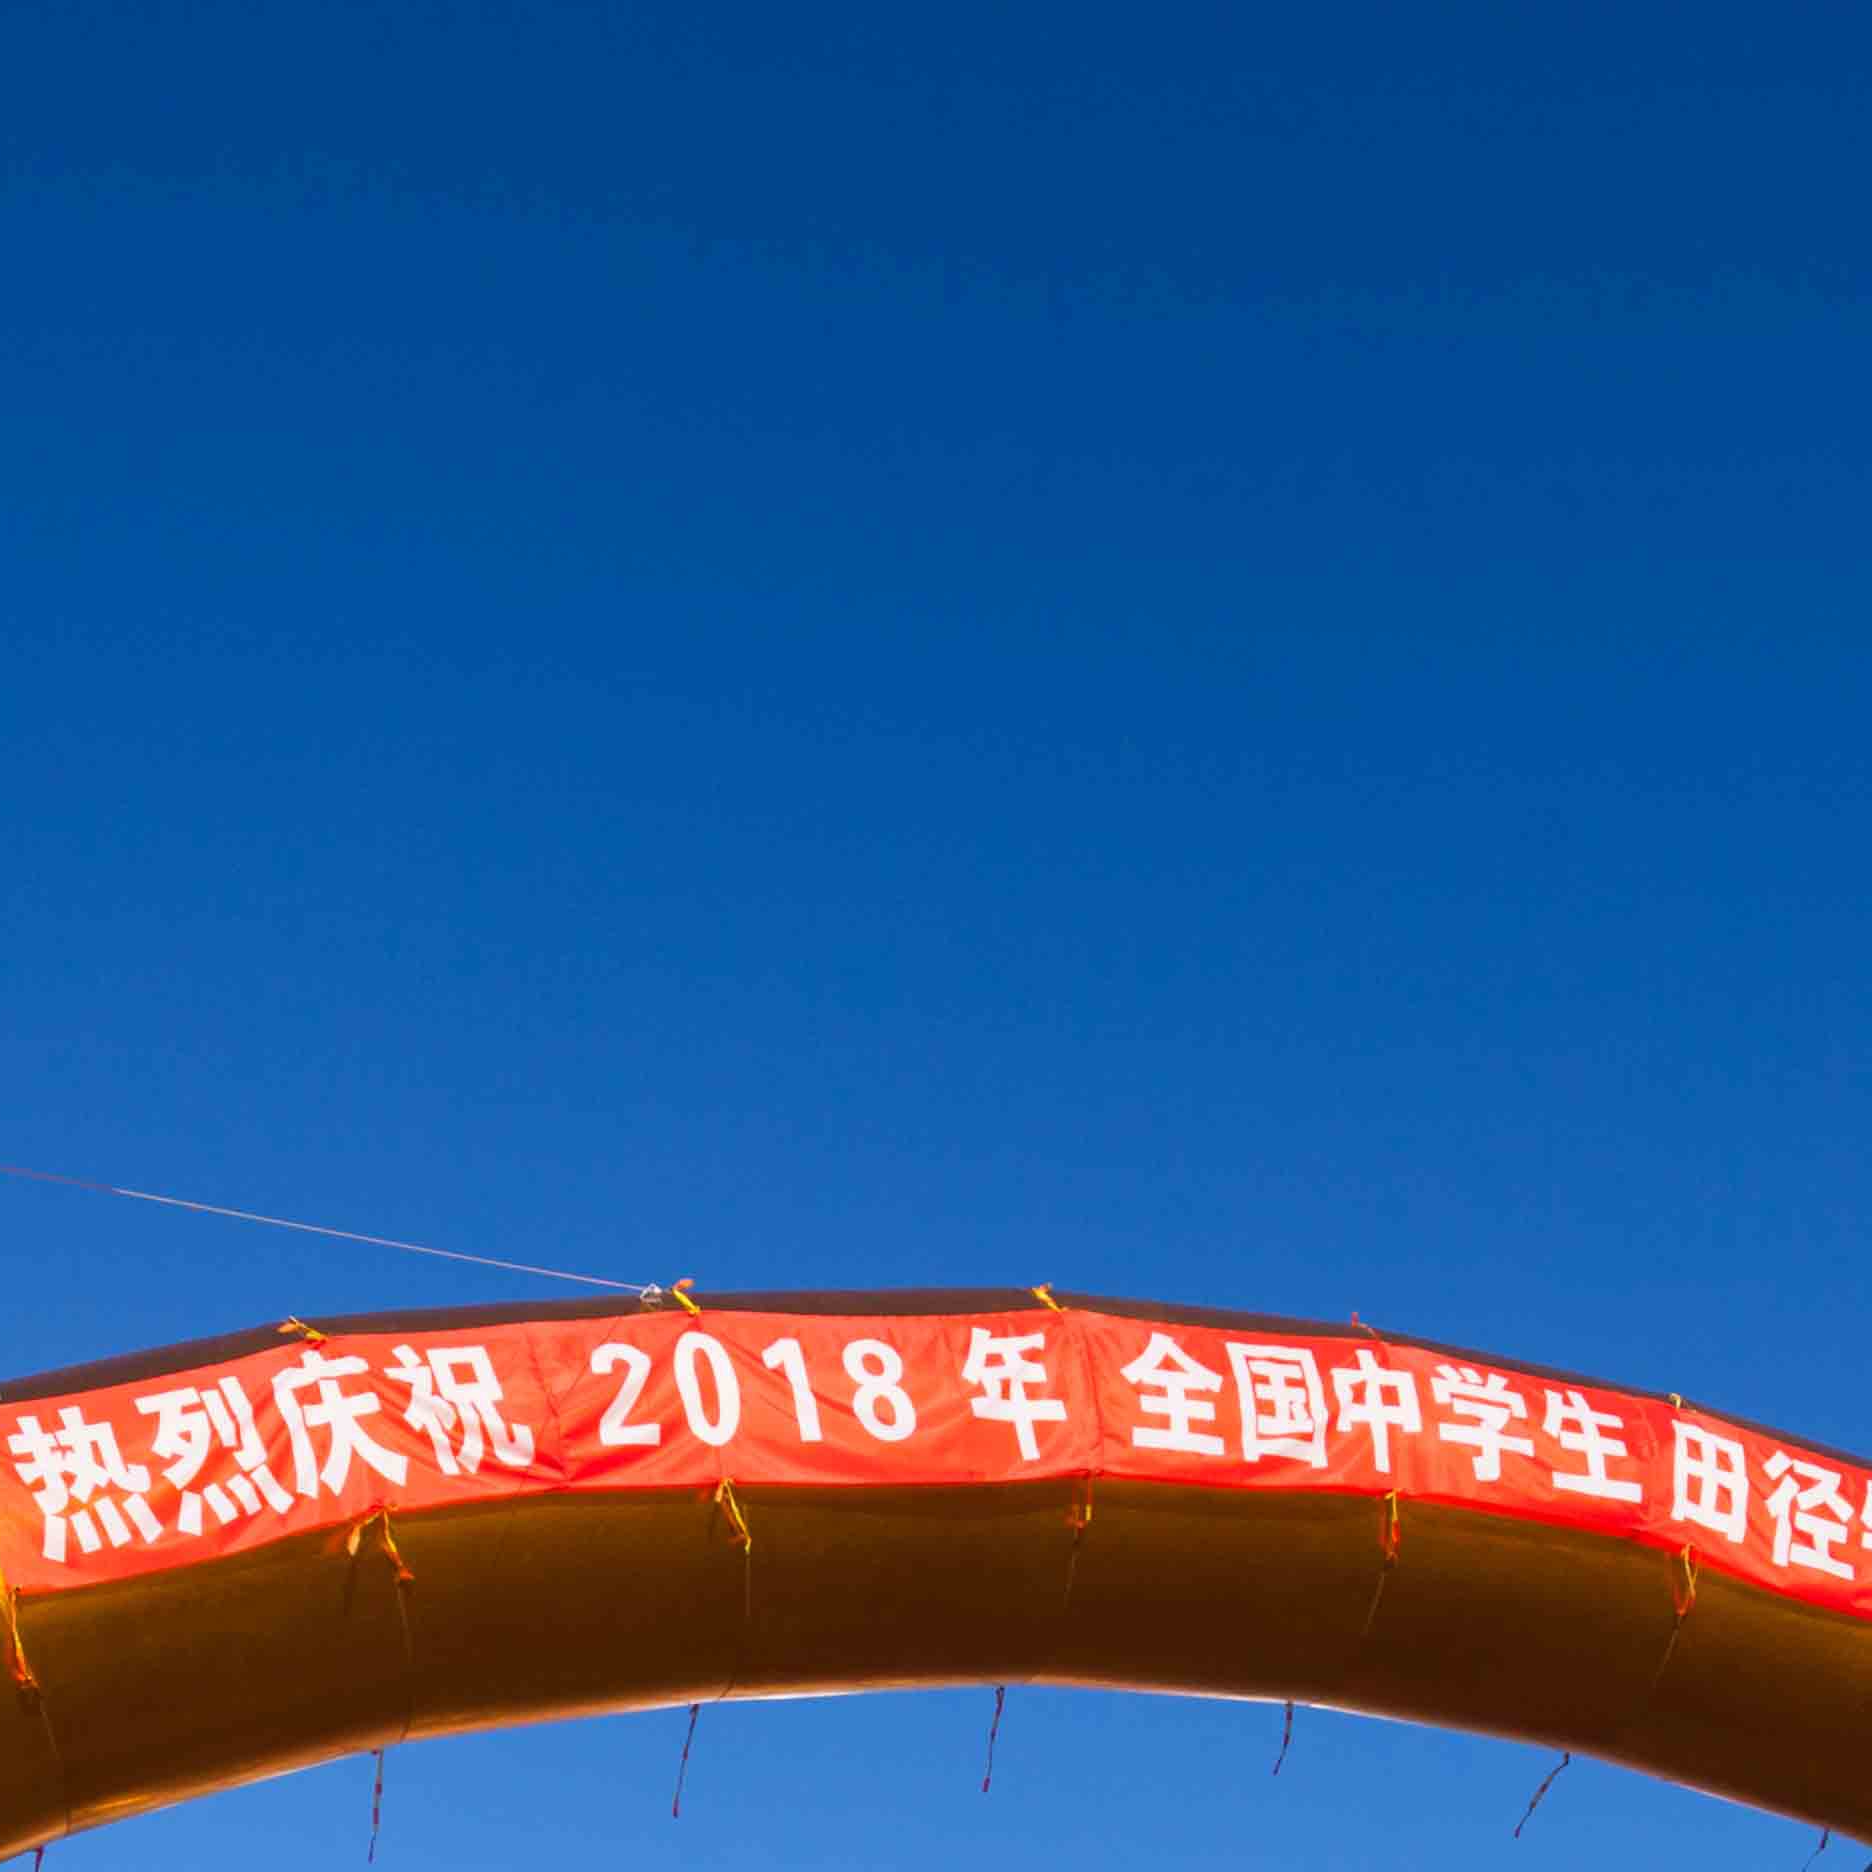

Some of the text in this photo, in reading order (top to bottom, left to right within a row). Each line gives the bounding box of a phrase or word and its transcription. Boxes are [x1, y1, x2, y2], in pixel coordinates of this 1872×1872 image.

[8, 1343, 535, 1562] 热烈庆祝
[590, 1331, 917, 1446] 2018
[961, 1326, 1068, 1461] 年
[1121, 1333, 1643, 1503] 全国中学生
